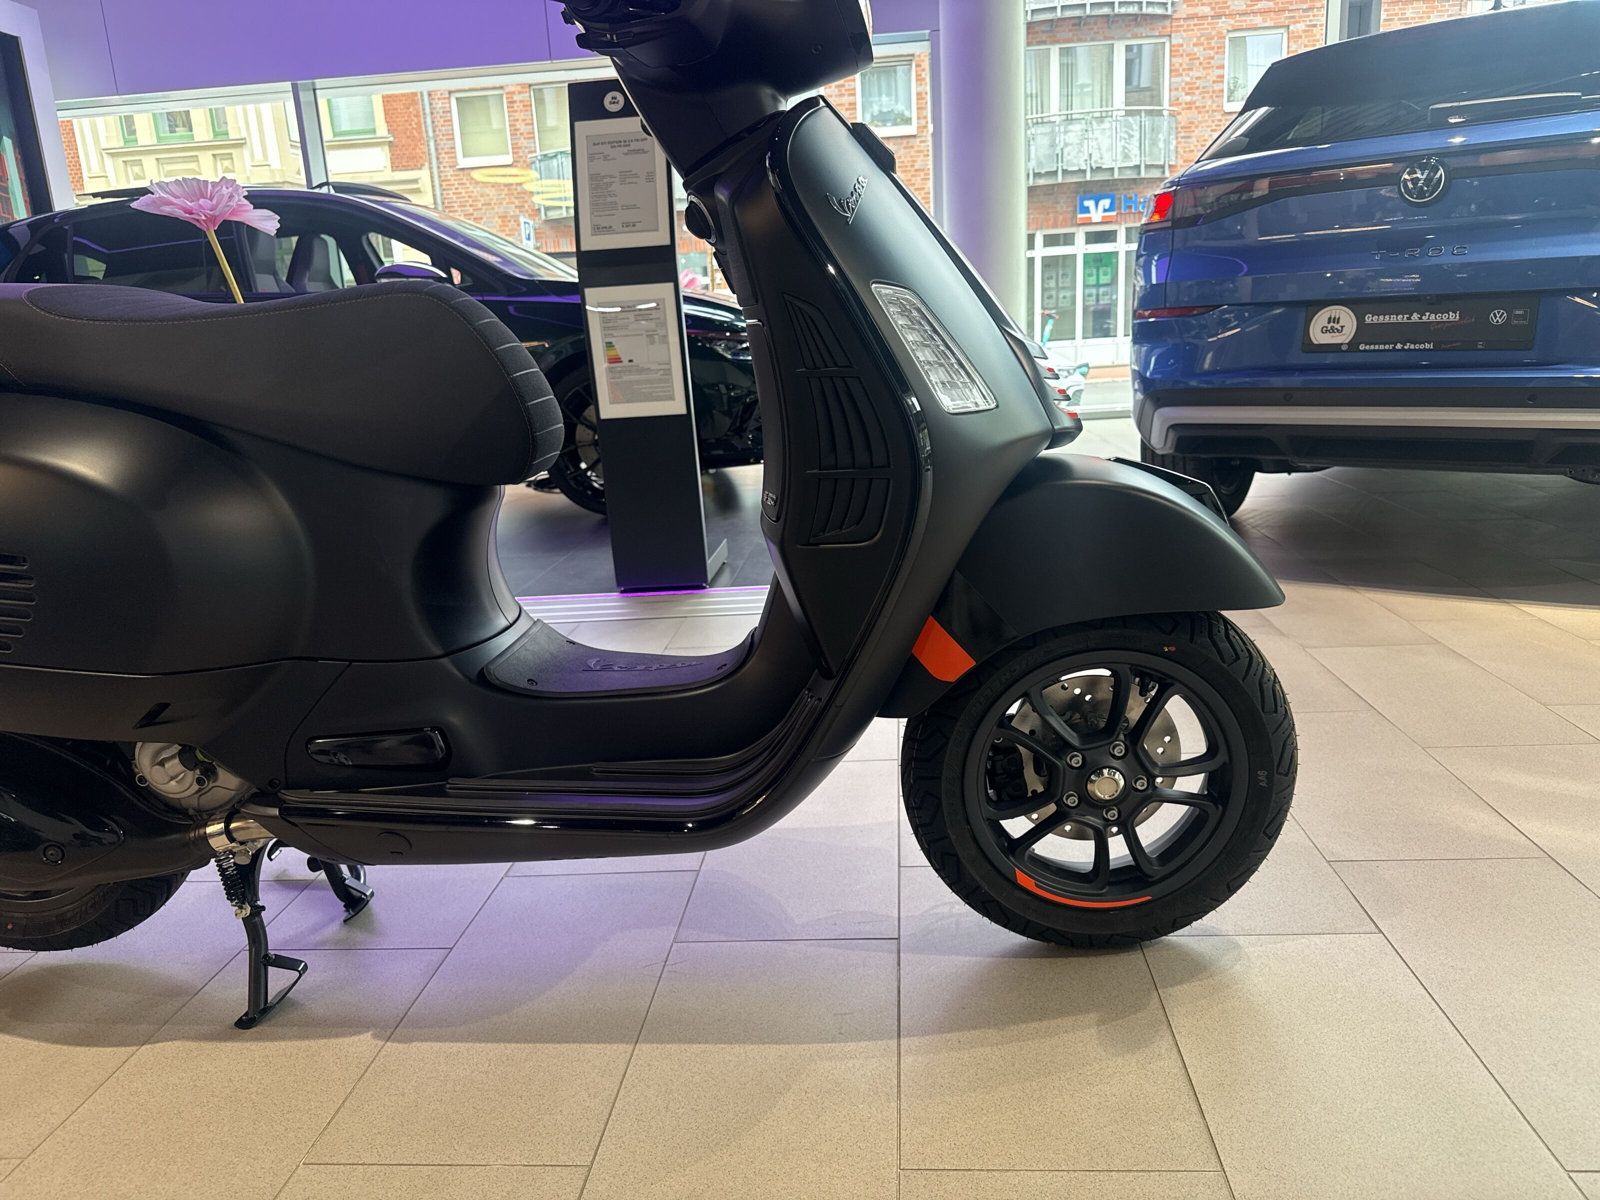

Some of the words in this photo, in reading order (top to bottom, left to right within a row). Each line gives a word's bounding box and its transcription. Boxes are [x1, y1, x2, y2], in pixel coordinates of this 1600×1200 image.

[1364, 313, 1410, 322] Gessner
[1410, 312, 1421, 321] &
[1422, 311, 1460, 321] Jacobi
[1320, 325, 1345, 334] G&J
[1395, 342, 1404, 350] &
[1404, 342, 1434, 350] Jacobi
